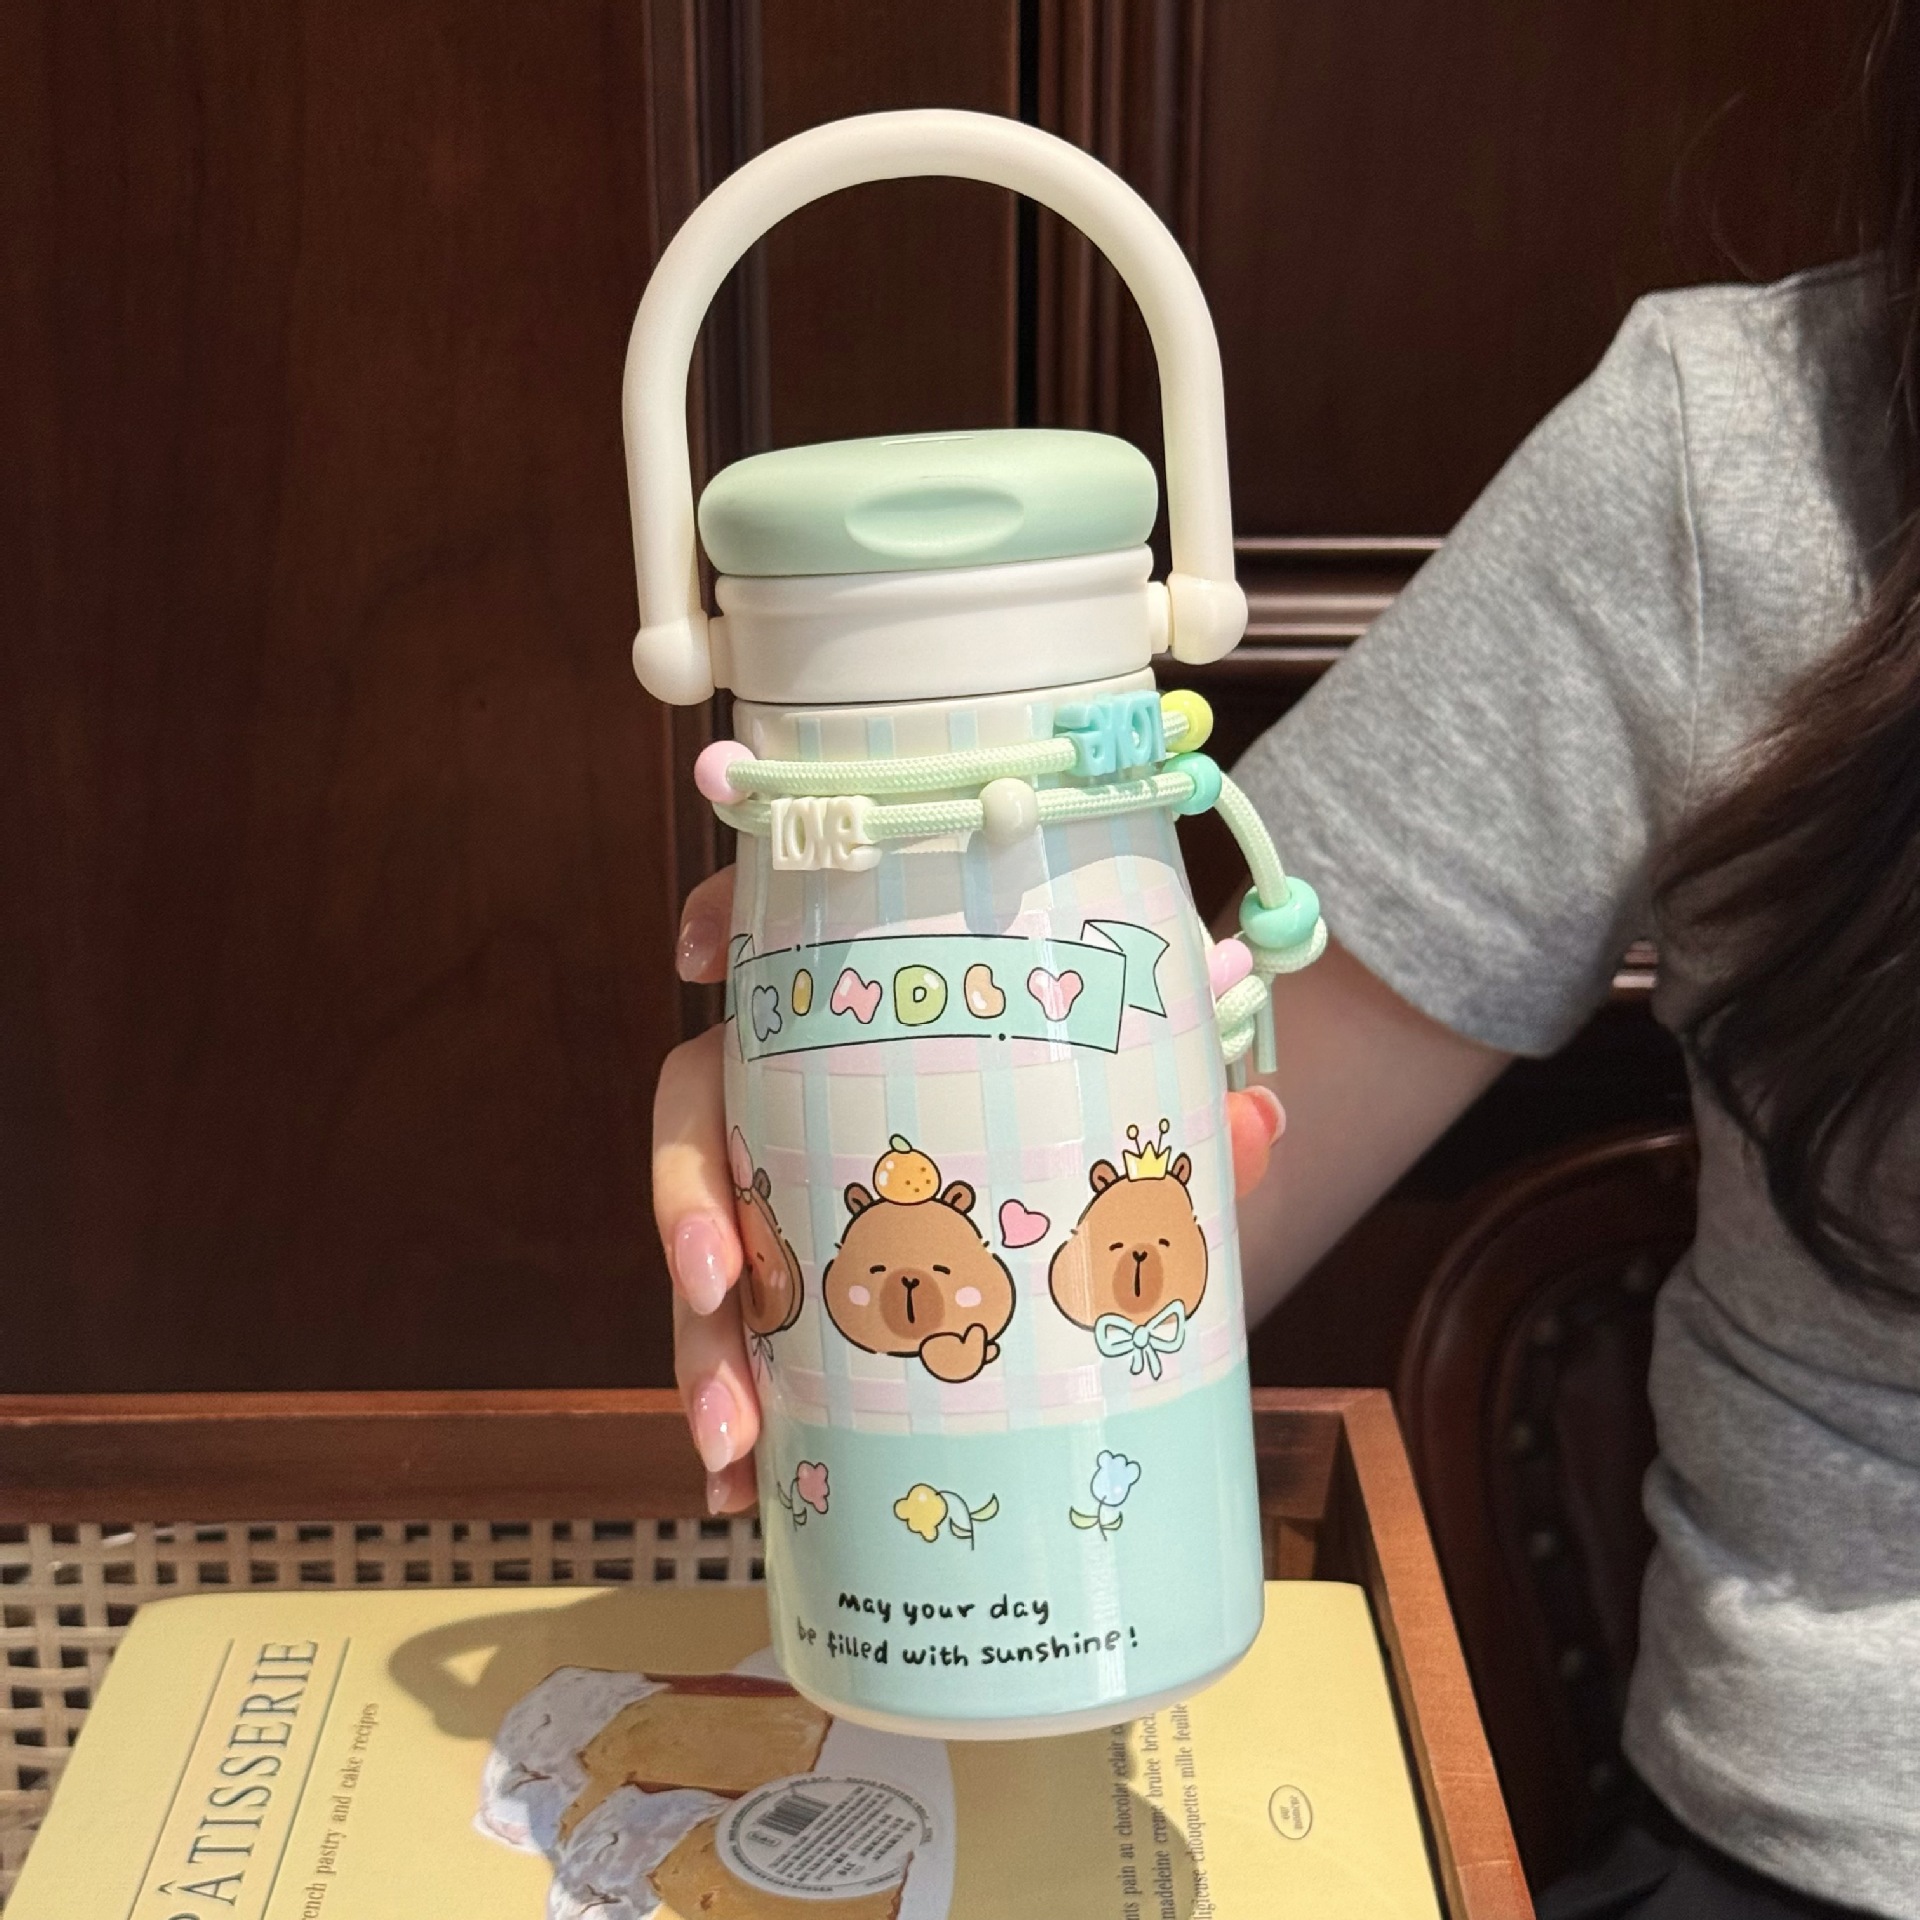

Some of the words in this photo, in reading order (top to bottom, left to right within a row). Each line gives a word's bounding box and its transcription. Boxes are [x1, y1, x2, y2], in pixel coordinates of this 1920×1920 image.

[751, 962, 1084, 1042] KINDLY
[903, 1601, 975, 1626] your
[989, 1593, 1050, 1624] day
[797, 1616, 816, 1646] be
[827, 1630, 888, 1664] filled
[902, 1643, 969, 1667] with
[353, 1701, 381, 1753] recipes
[1170, 1703, 1191, 1742] feuille
[158, 1641, 318, 1920] ÂTISSERIE
[339, 1754, 365, 1790] cake
[1145, 1757, 1165, 1798] brulee
[1174, 1746, 1195, 1779] mille
[332, 1795, 354, 1822] and
[1113, 1782, 1133, 1836] chocolat
[1184, 1784, 1206, 1861] chouquettes
[315, 1829, 347, 1875] pastry
[1121, 1841, 1136, 1860] au
[1119, 1864, 1142, 1896] pain
[1153, 1850, 1176, 1920] madeleine
